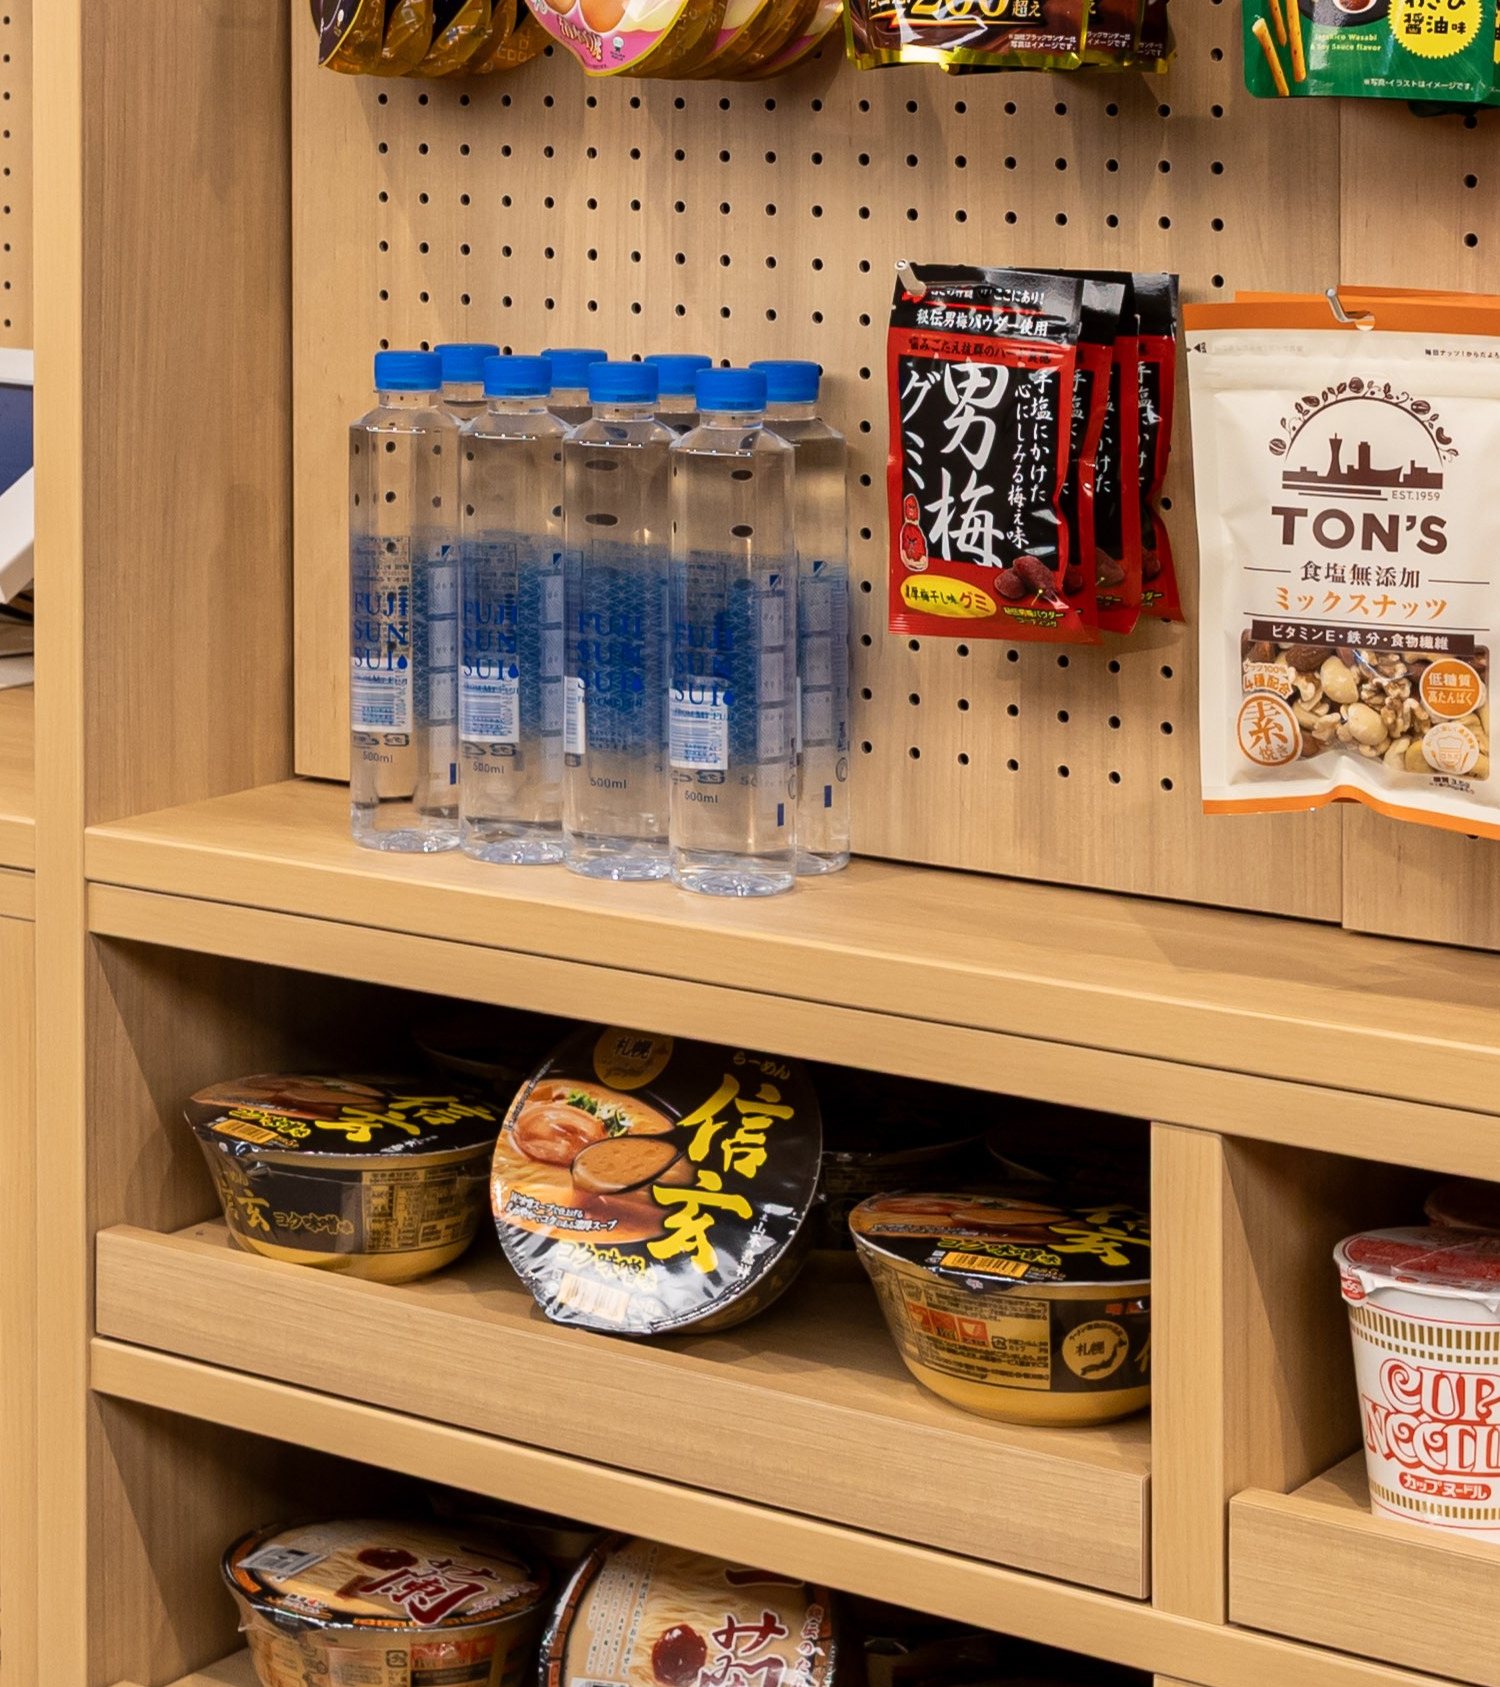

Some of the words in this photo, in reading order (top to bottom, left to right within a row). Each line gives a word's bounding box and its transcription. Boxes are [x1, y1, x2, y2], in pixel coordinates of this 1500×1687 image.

[1405, 13, 1467, 35] 醤油味
[917, 308, 1049, 337] 秘伝男梅パウダー使用
[901, 369, 942, 490] グミ
[924, 362, 1010, 569] 男梅
[1392, 490, 1441, 502] EST.1959
[1271, 505, 1448, 555] TON'S
[1301, 561, 1421, 589] 食塩無添加
[355, 592, 408, 617] FUJI
[1275, 586, 1448, 620] ミックスナッツ
[354, 621, 408, 645] SUN
[354, 647, 394, 671] SUI
[464, 655, 505, 681] SUI
[1429, 672, 1471, 687] 低糖質
[674, 681, 723, 708] SUI
[1428, 690, 1473, 705] 高たんぱく
[363, 751, 393, 763] 500ml
[473, 763, 505, 774] 500ml
[590, 778, 628, 789] 500ml
[685, 791, 719, 804] 500ml
[614, 1036, 653, 1058] 札幌
[647, 1073, 795, 1274] 信玄
[1403, 1473, 1489, 1499] カップヌードル
